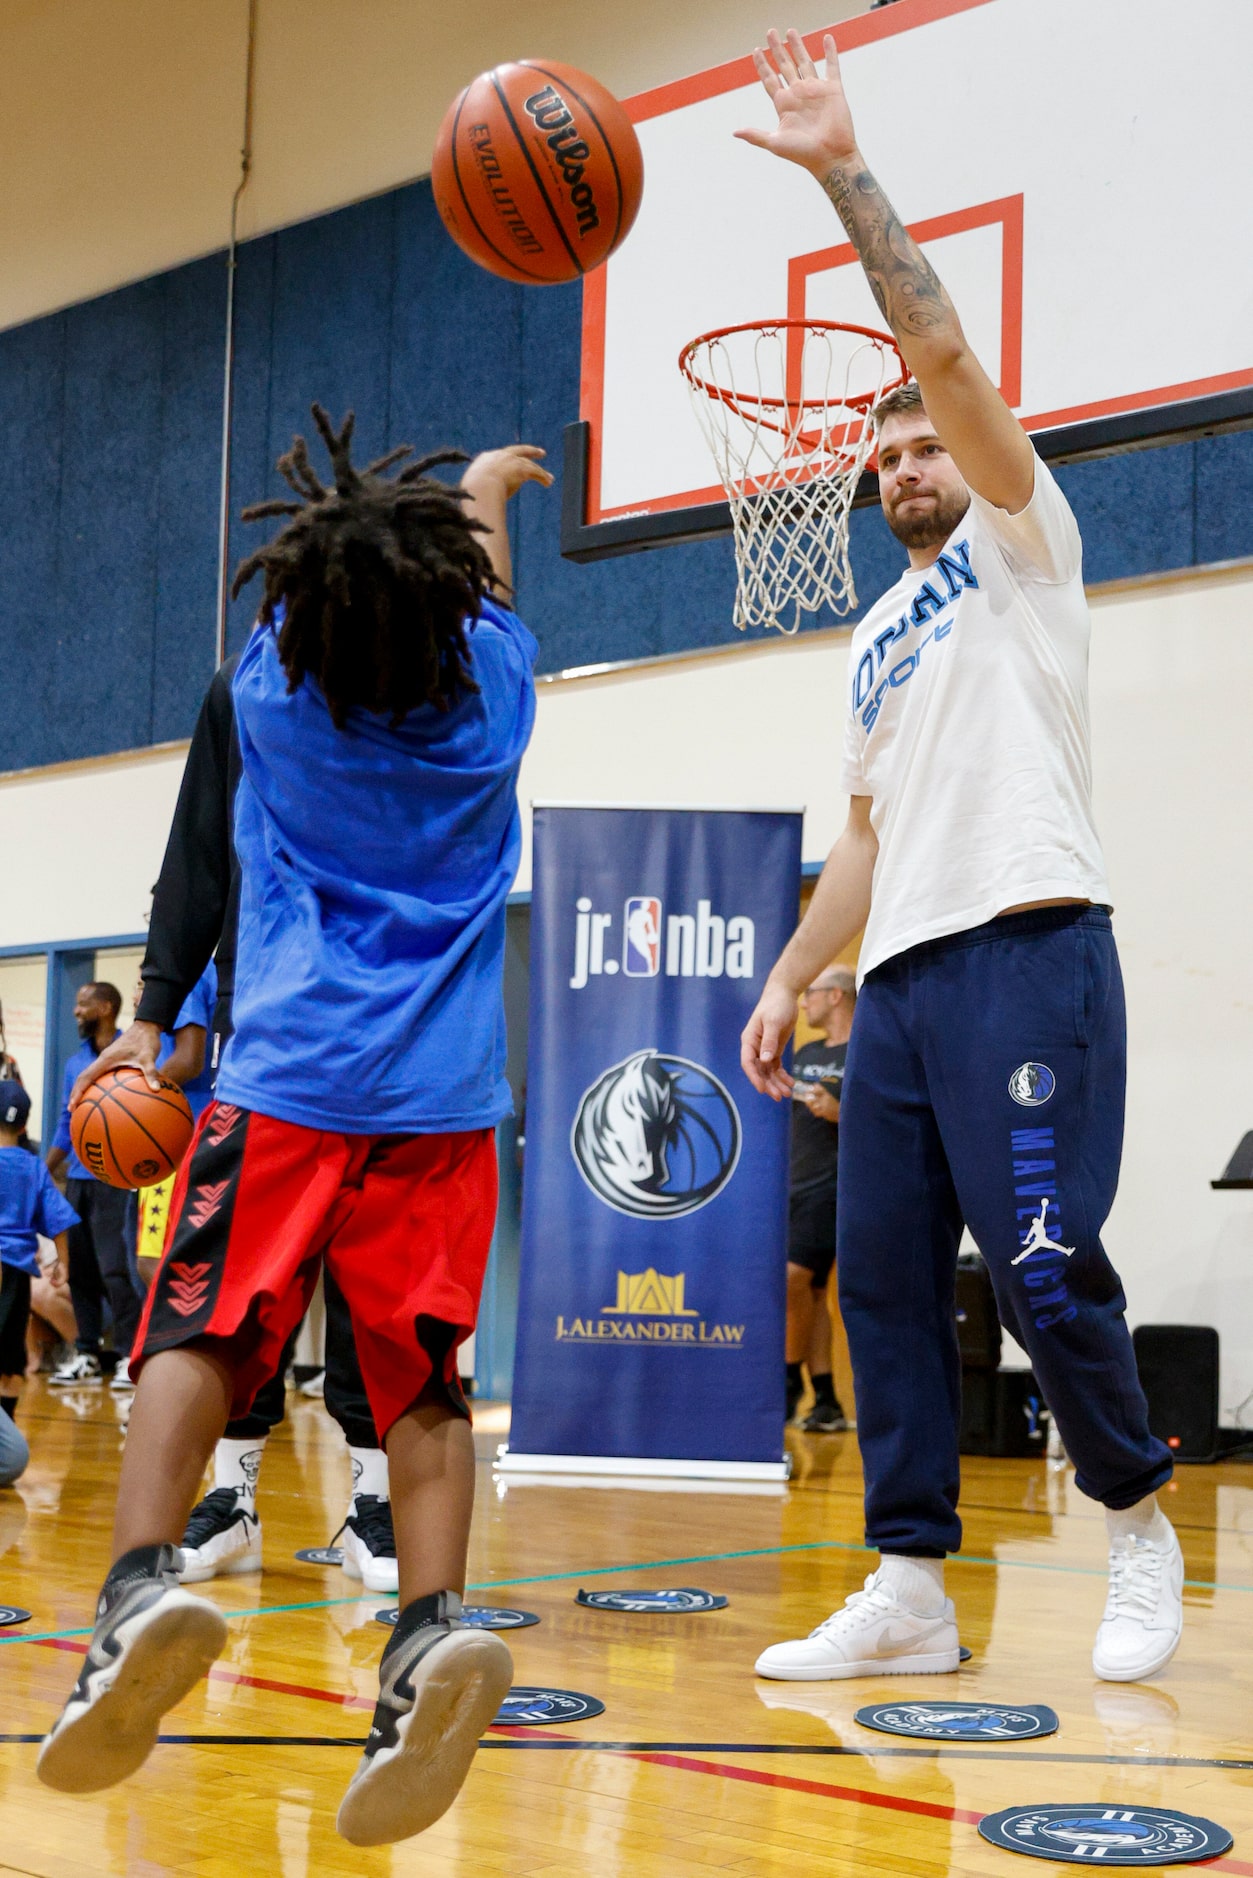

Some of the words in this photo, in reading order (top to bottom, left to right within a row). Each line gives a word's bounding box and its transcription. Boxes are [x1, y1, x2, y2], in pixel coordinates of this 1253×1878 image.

[523, 84, 600, 238] Wilson
[469, 123, 544, 255] EVOLUTION
[570, 897, 619, 989] jr.
[666, 899, 755, 978] nba
[700, 1321, 746, 1343] LAW
[976, 1708, 1027, 1724] MAVS
[1015, 1815, 1050, 1837] MAVS
[1142, 1821, 1195, 1856] ACADEMY
